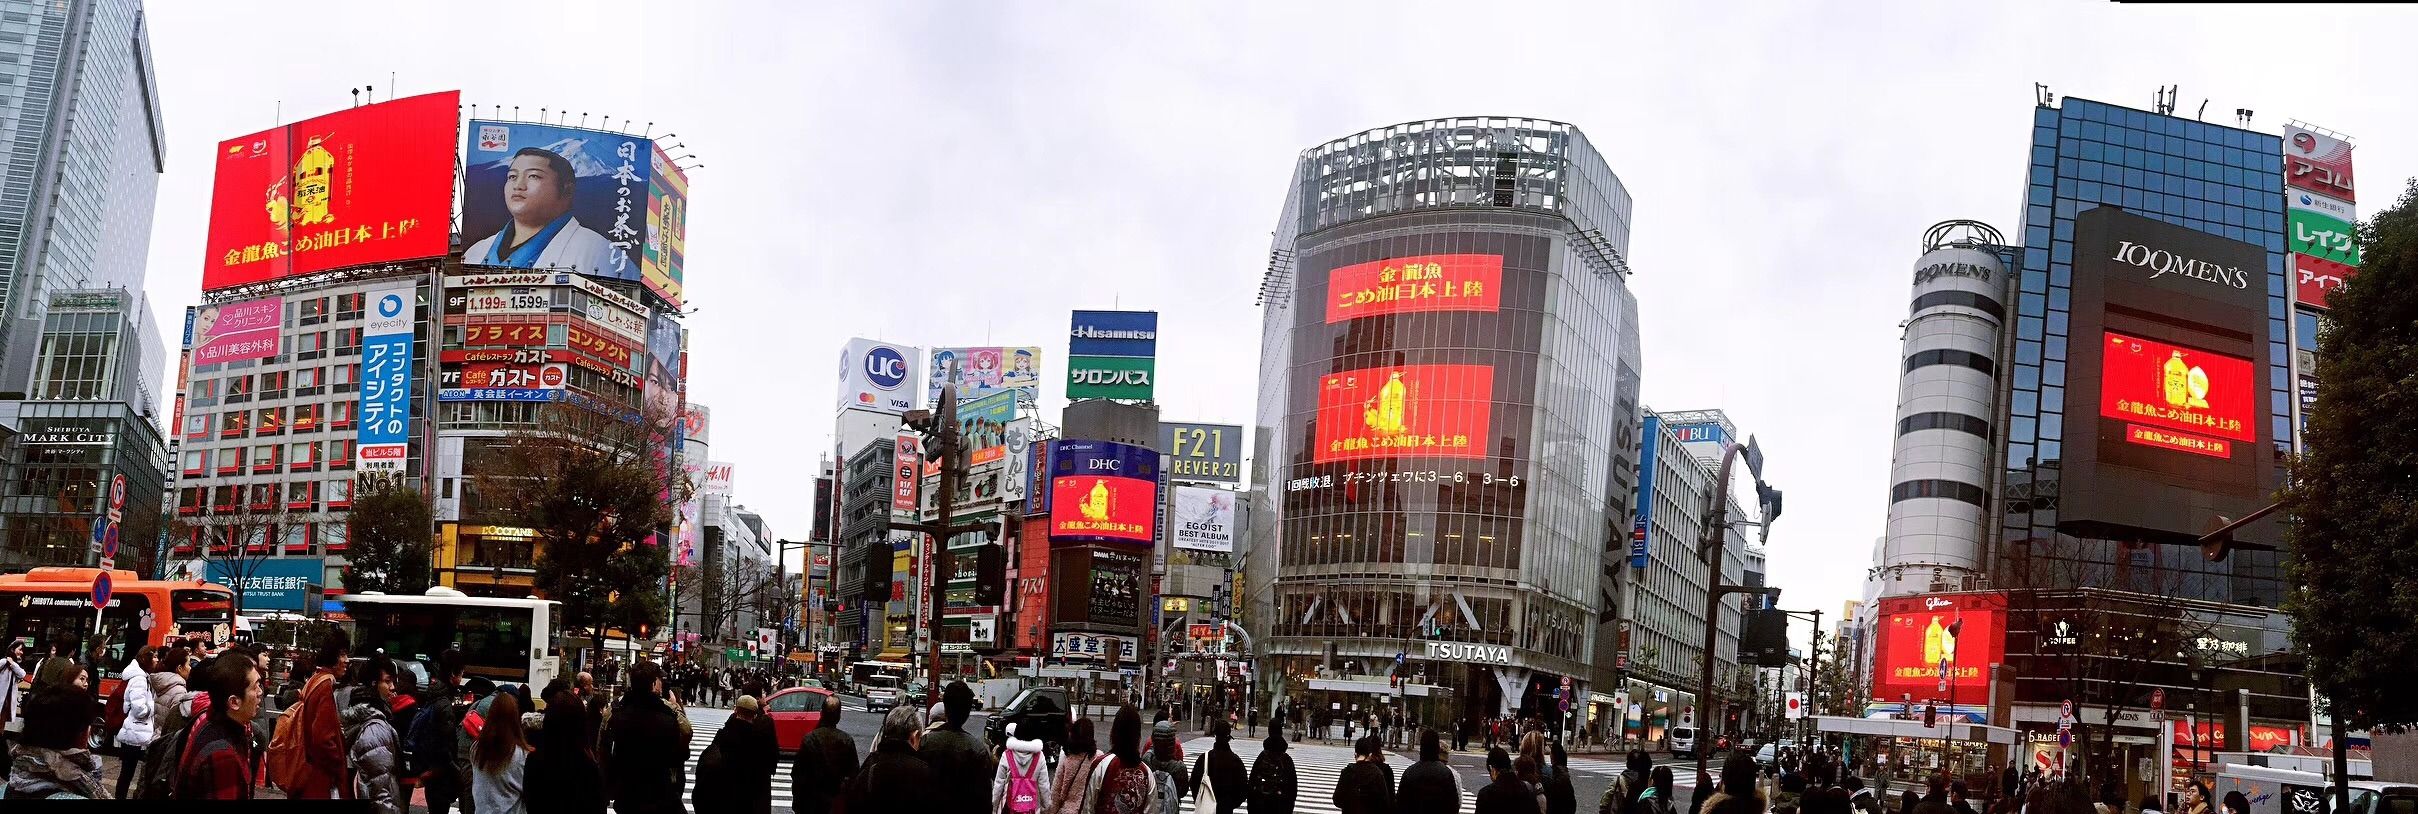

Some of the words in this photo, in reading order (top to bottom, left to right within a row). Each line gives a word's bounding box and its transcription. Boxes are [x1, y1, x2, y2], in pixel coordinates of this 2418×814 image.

[2294, 160, 2353, 192] アコム
[608, 141, 642, 272] 日本のお茶づけ
[2296, 221, 2353, 251] レイク
[462, 275, 548, 286] しゃぶしゃぶバイキング
[1379, 262, 1443, 283] 金龍魚
[449, 297, 466, 307] 9F
[1339, 281, 1483, 308] こめ油日本上陸
[234, 303, 278, 318] 品川スキン
[469, 296, 507, 312] 1,199円
[510, 295, 549, 311] 1,599円
[233, 314, 272, 329] クリニック
[370, 318, 408, 329] eyecity
[467, 326, 544, 341] プライス
[1071, 324, 1156, 340] Hisamitsu
[206, 338, 274, 360] 品川美容外科
[568, 328, 628, 362] コンタクト
[514, 350, 553, 364] ガスト
[441, 371, 461, 383] 7F
[489, 369, 536, 387] ガスト
[611, 369, 639, 388] ガスト
[1071, 368, 1150, 386] サロンパス
[364, 344, 388, 435] アイシティ
[387, 342, 407, 434] コンタクトの
[442, 390, 466, 398] AEON
[473, 389, 544, 399] 英会話イーオン
[890, 399, 909, 409] VISA
[2116, 399, 2243, 433] 金龍魚こめ油日本上陸
[23, 433, 70, 442] MARK
[76, 433, 116, 442] CITY
[1672, 427, 1709, 441] IBU
[2133, 428, 2225, 454] 金龍魚こめ油日本上陸
[1172, 428, 1222, 458] F21
[1329, 434, 1470, 454] 金龍魚こめ油日本上陸
[365, 448, 401, 457] 当ビル5階
[1004, 428, 1028, 499] もんじゃ
[1088, 458, 1121, 471] DHC
[1174, 461, 1219, 476] REVER
[1223, 462, 1238, 478] 21
[706, 465, 732, 482] H&M
[1156, 508, 1165, 540] neon
[1186, 522, 1223, 532] EGOIST
[1179, 530, 1198, 538] BEST
[1201, 532, 1229, 541] ALBUM
[1632, 513, 1648, 558] SEIBU
[32, 597, 54, 606] SHIBUYA
[54, 598, 84, 609] community
[1926, 597, 1953, 610] Glico
[1055, 636, 1134, 657] 大盛堂店
[1428, 643, 1509, 663] TSUTAYA
